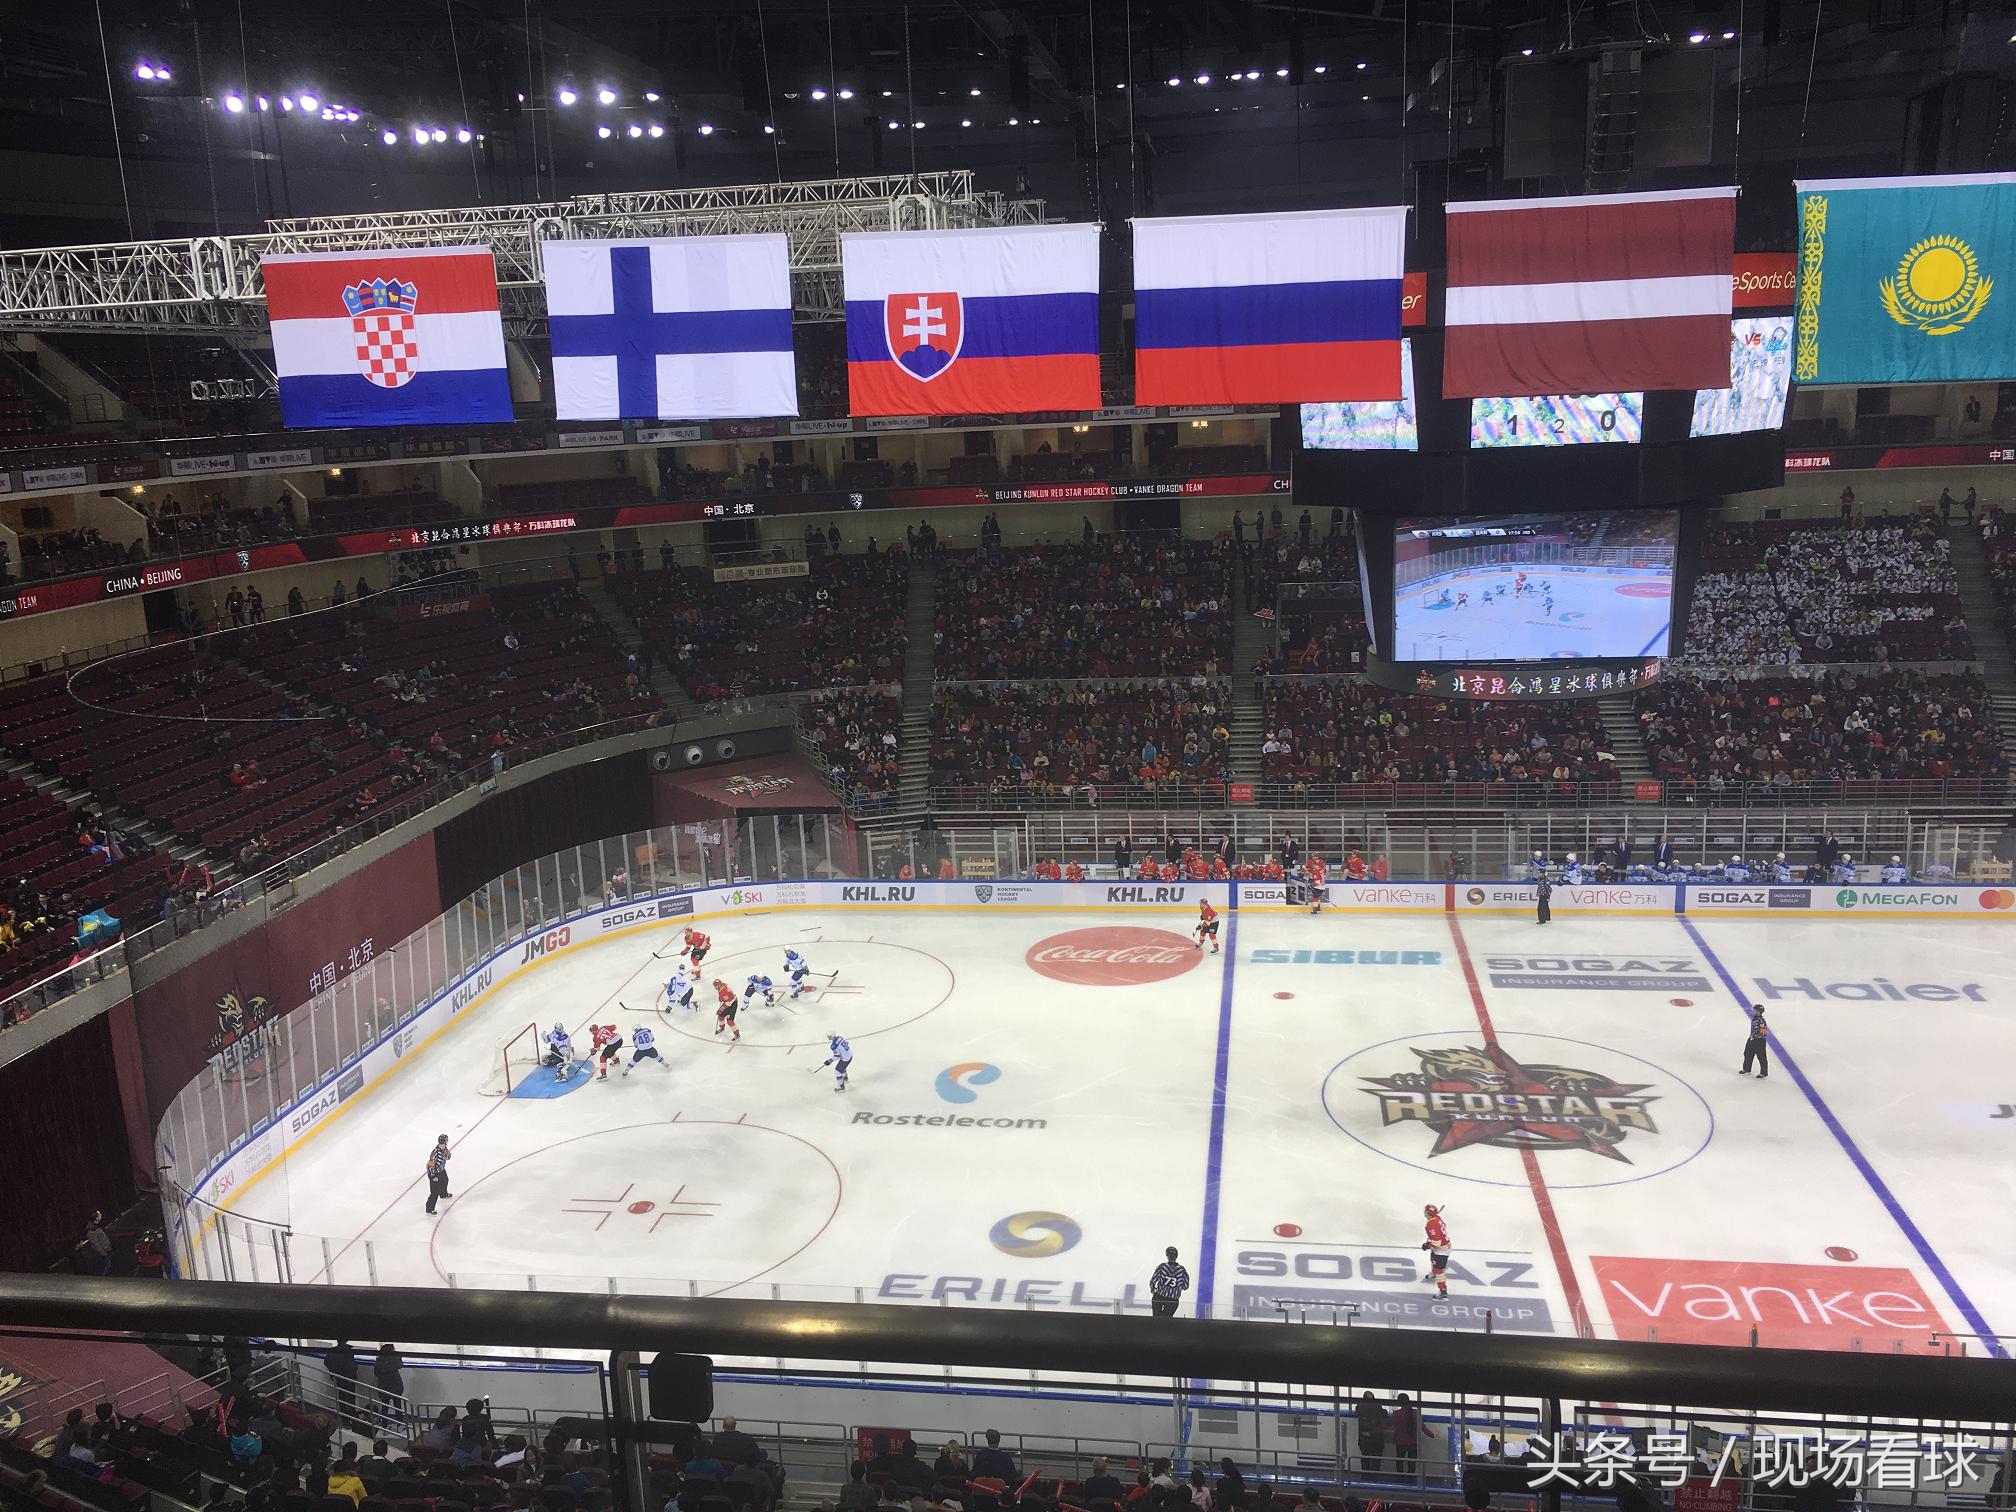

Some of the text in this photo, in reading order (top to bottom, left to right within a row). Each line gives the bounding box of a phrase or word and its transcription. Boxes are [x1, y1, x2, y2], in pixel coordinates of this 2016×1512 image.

[1507, 410, 1616, 435] 1 2 0
[1989, 449, 2015, 461] 中国
[995, 481, 1203, 500] BEIJING KUNLUN RED STAR HOCKEY CLUB VANKE DRAGON TEAM
[106, 568, 182, 593] CHINA BEIJING
[18, 595, 37, 609] TEAM
[842, 886, 916, 902] KHL.RU
[1107, 886, 1185, 903] KHL.RU
[1353, 888, 1412, 904] vanke
[1570, 888, 1633, 905] vanke
[1698, 892, 1766, 904] SOGAZ
[602, 906, 657, 929] SOGAZ
[1249, 949, 1442, 966] SIBUR
[1487, 957, 1700, 974] SOGAZ
[451, 966, 493, 1014] KHL.RU
[1500, 975, 1700, 990] INSURANCE GROUP
[1752, 977, 1989, 1002] Haier
[638, 1032, 651, 1045] 48
[292, 1089, 338, 1133] SOGAZ
[1368, 1090, 1656, 1131] REDSTAR
[851, 1111, 1048, 1130] Rostelecom
[1236, 1250, 1541, 1289] SOGAZ
[1163, 1275, 1178, 1288] 73
[877, 1273, 1153, 1310] ERIELL
[1431, 1303, 1536, 1320] GROUP
[1610, 1279, 1932, 1330] vanke
